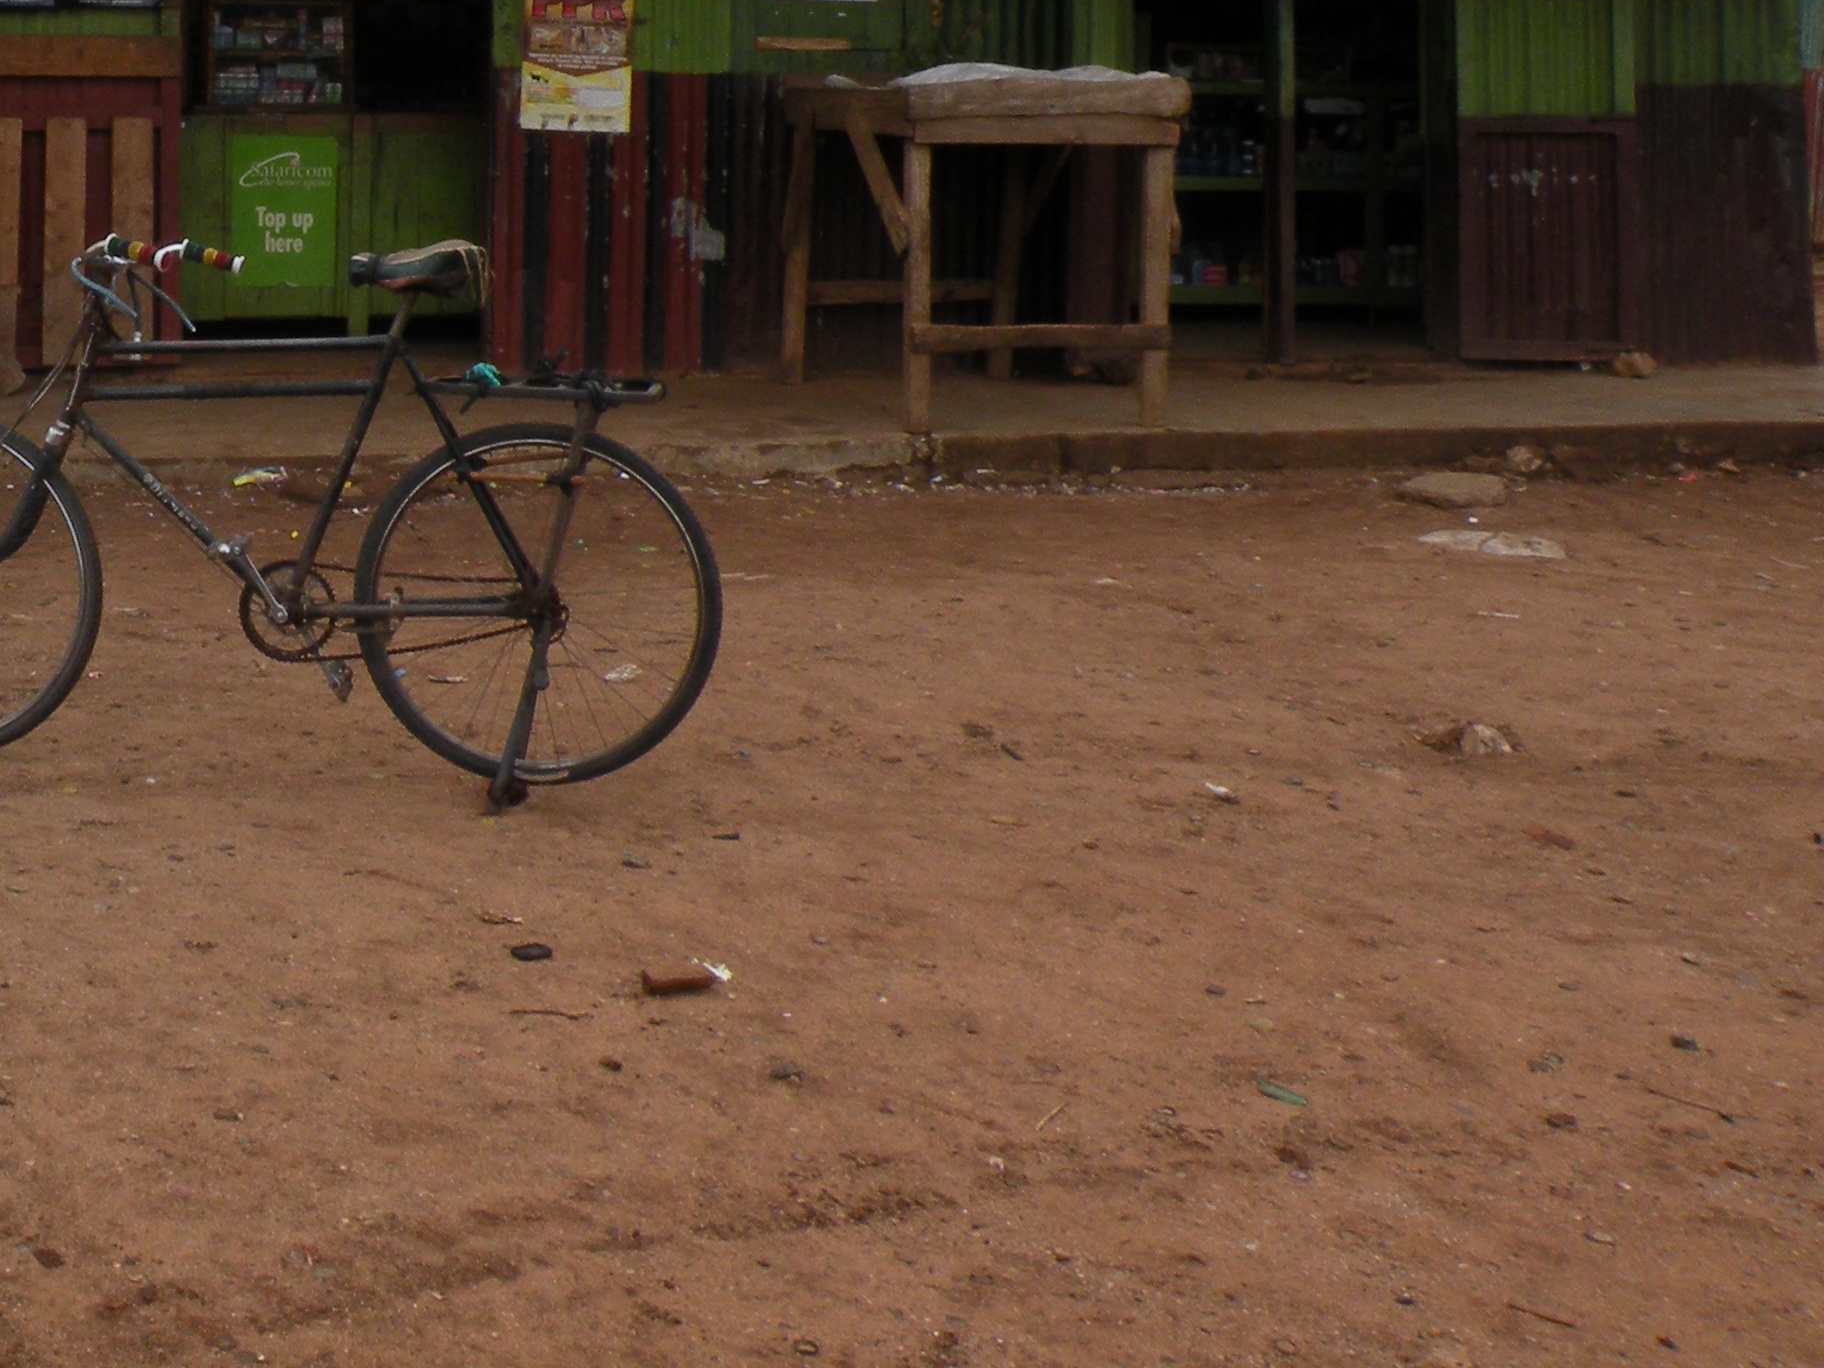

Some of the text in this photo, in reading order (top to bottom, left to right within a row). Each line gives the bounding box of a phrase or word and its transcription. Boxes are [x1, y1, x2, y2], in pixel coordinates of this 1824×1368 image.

[250, 162, 333, 179] Safaricom
[254, 205, 315, 235] Top up
[264, 230, 305, 253] here
